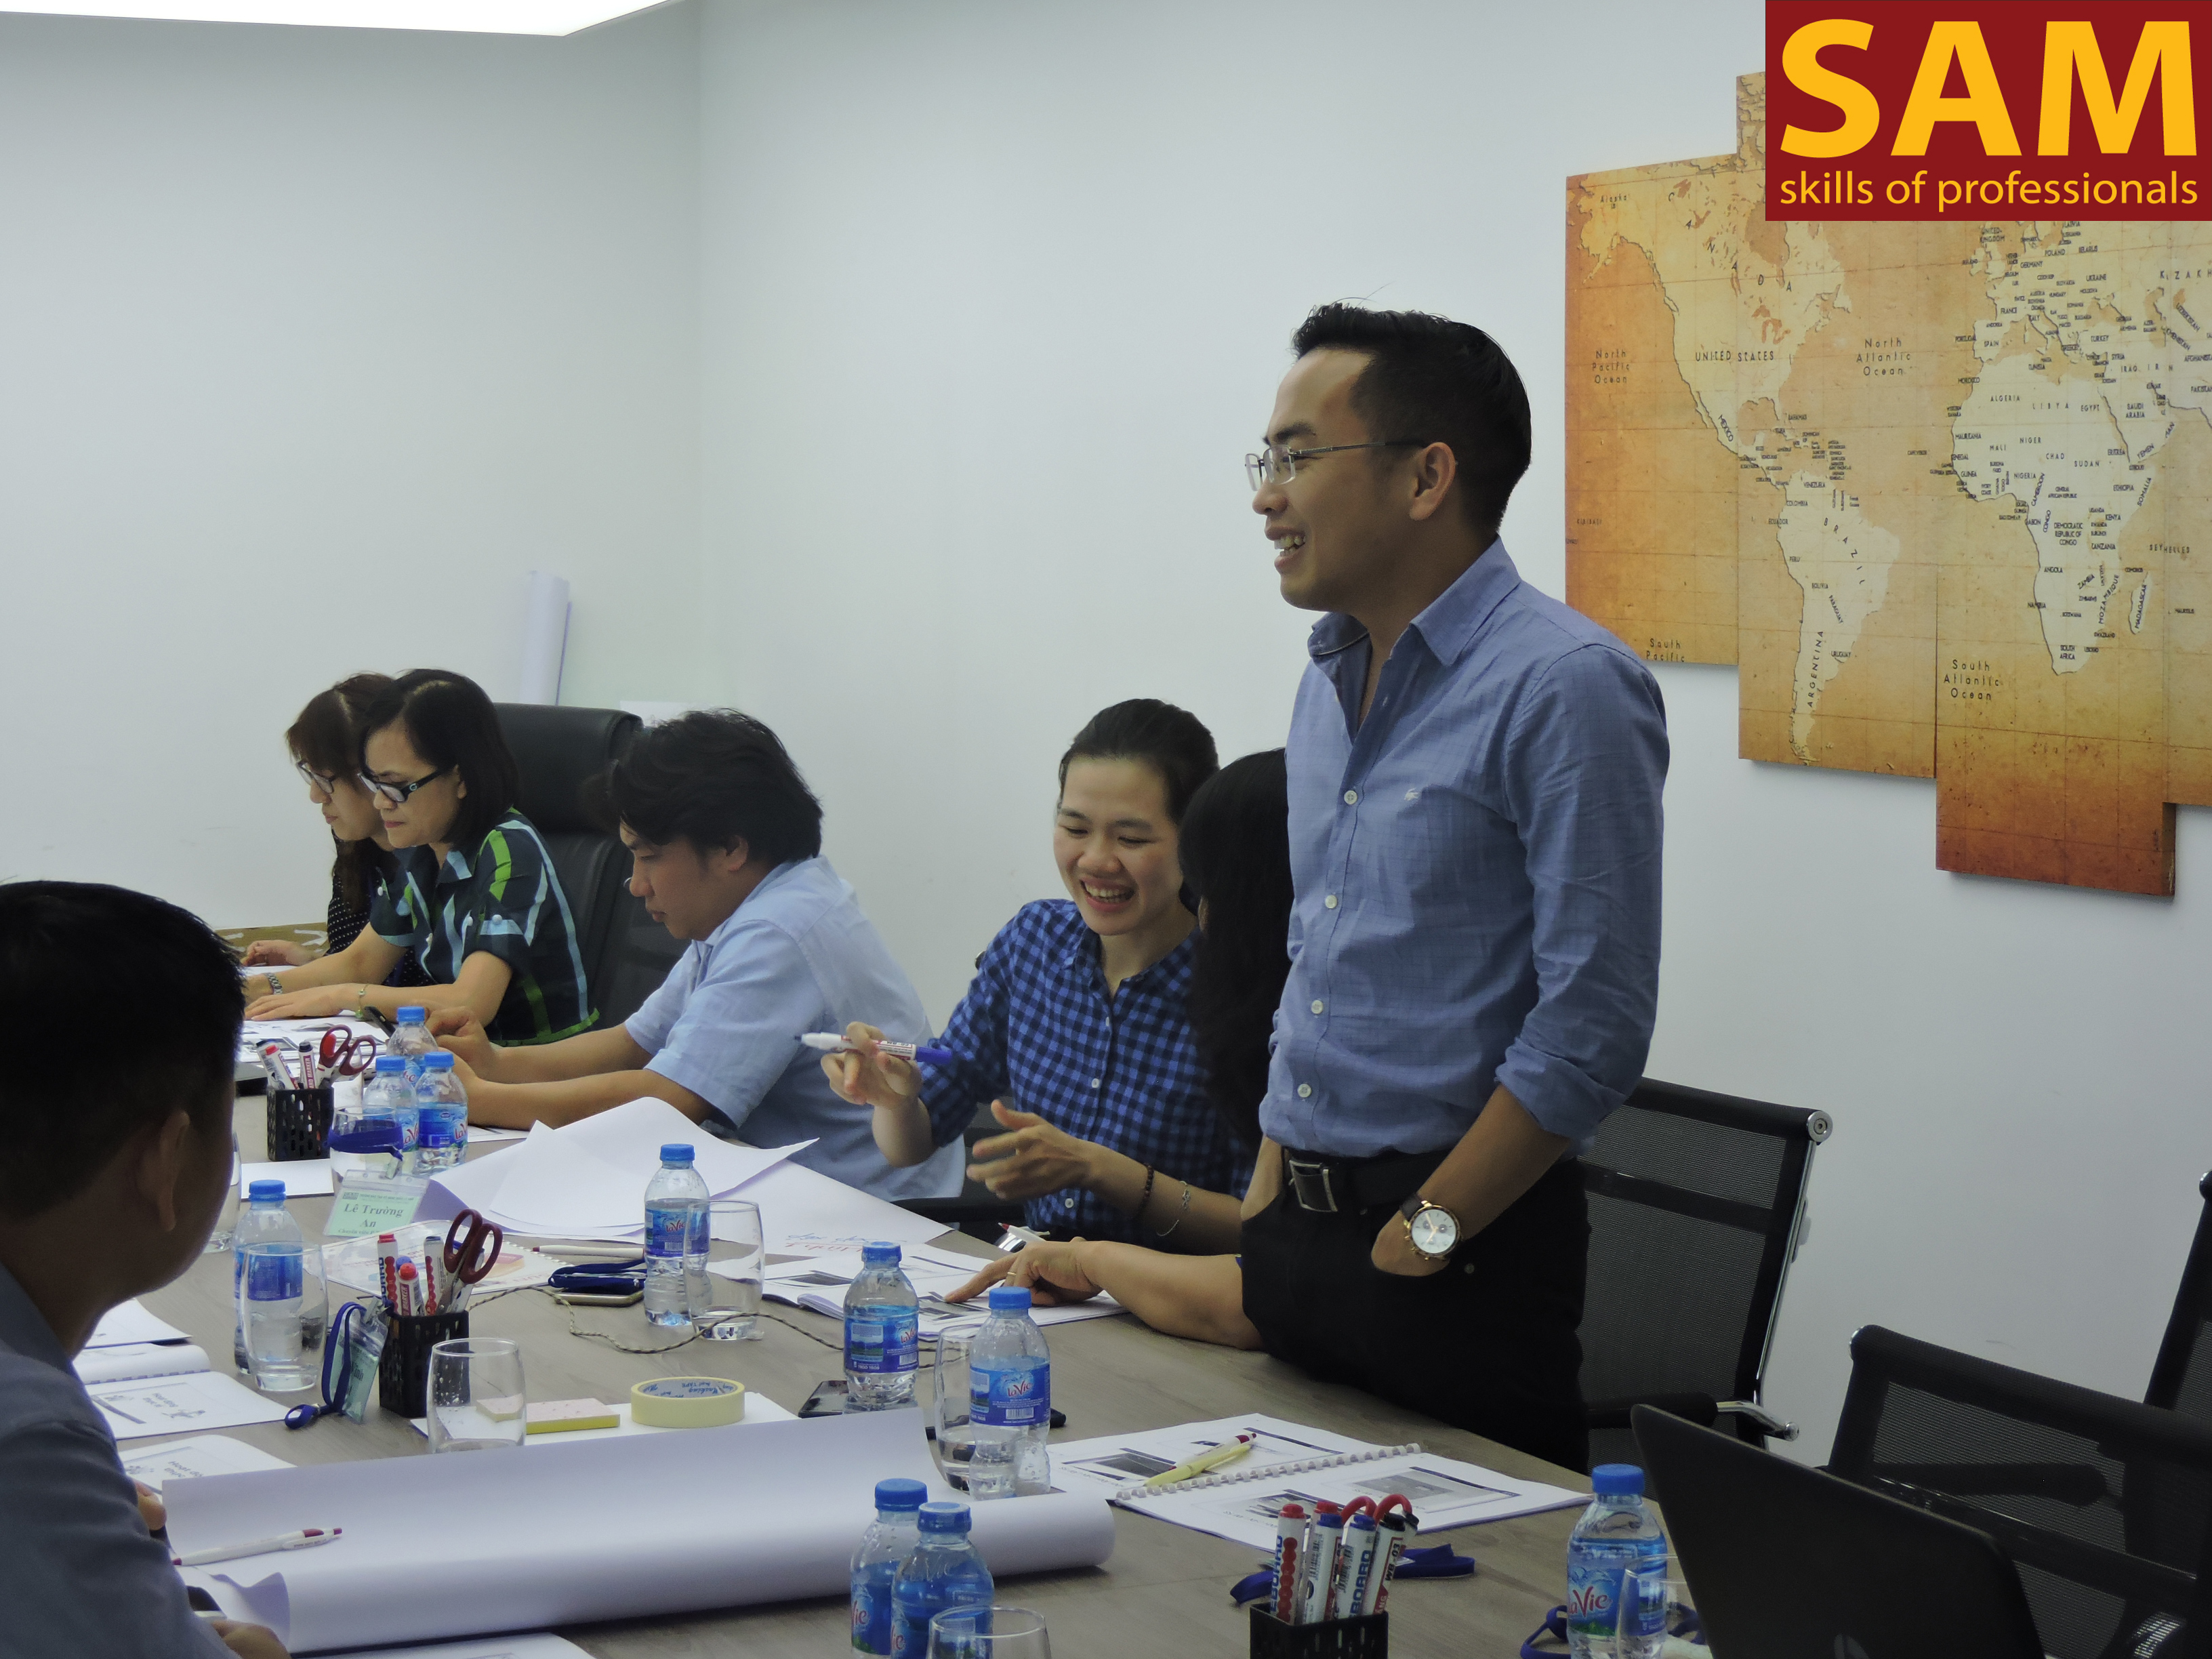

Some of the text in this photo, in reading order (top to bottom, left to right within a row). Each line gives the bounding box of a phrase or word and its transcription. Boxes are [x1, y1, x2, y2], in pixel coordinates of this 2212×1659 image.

[1601, 193, 1626, 203] Alaska
[2086, 274, 2107, 282] UKRAINE
[1864, 337, 1902, 349] North
[1595, 348, 1626, 359] North
[1696, 350, 1775, 362] UNITED STATES
[1856, 351, 1911, 363] Atlantic
[1593, 362, 1630, 371] Pacific
[1864, 366, 1903, 376] Ocean
[1595, 374, 1627, 384] Ocean
[2081, 404, 2100, 412] EGYPT
[1718, 414, 1734, 442] MEXICO
[2137, 443, 2155, 459] YEMEN
[2137, 476, 2152, 507] SOMALIA
[2043, 510, 2051, 533] CONGO
[2135, 583, 2147, 630] MADAGASCAR
[1650, 638, 1681, 649] South
[1646, 650, 1685, 663] Pacific
[1807, 630, 1824, 708] ARGENTINA
[1952, 659, 1990, 672] South
[1944, 673, 1999, 687] Atlantic
[1950, 687, 1992, 701] Ocean
[344, 1203, 405, 1218] Lê Trường
